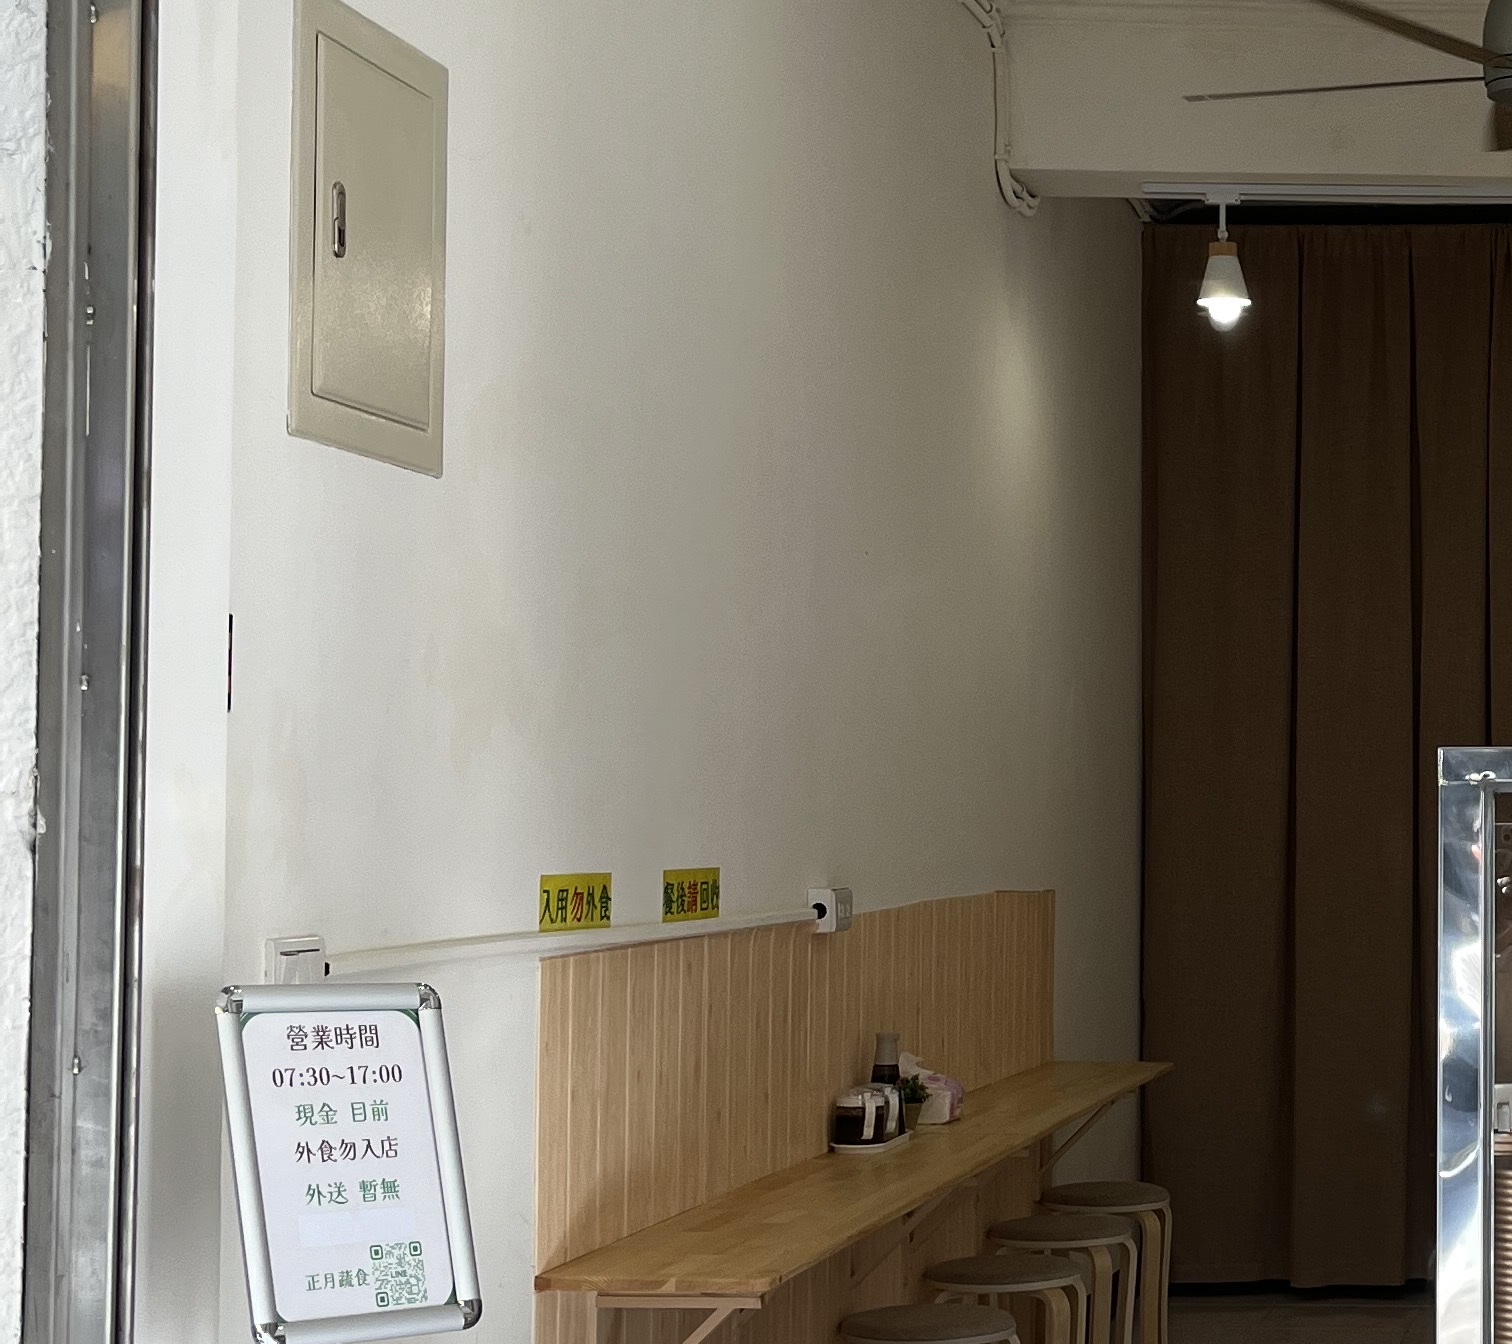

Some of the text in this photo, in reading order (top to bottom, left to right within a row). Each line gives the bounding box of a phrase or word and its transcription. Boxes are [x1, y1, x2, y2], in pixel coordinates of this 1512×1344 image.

[286, 1023, 380, 1051] 營業時間
[272, 1064, 402, 1087] 07:30~17:00
[294, 1099, 389, 1126] 現金 目前
[294, 1136, 398, 1164] 外食勿入店
[305, 1178, 400, 1206] 外送 暫無
[305, 1268, 370, 1291] 正月蔬食
[390, 1269, 407, 1279] LINE
